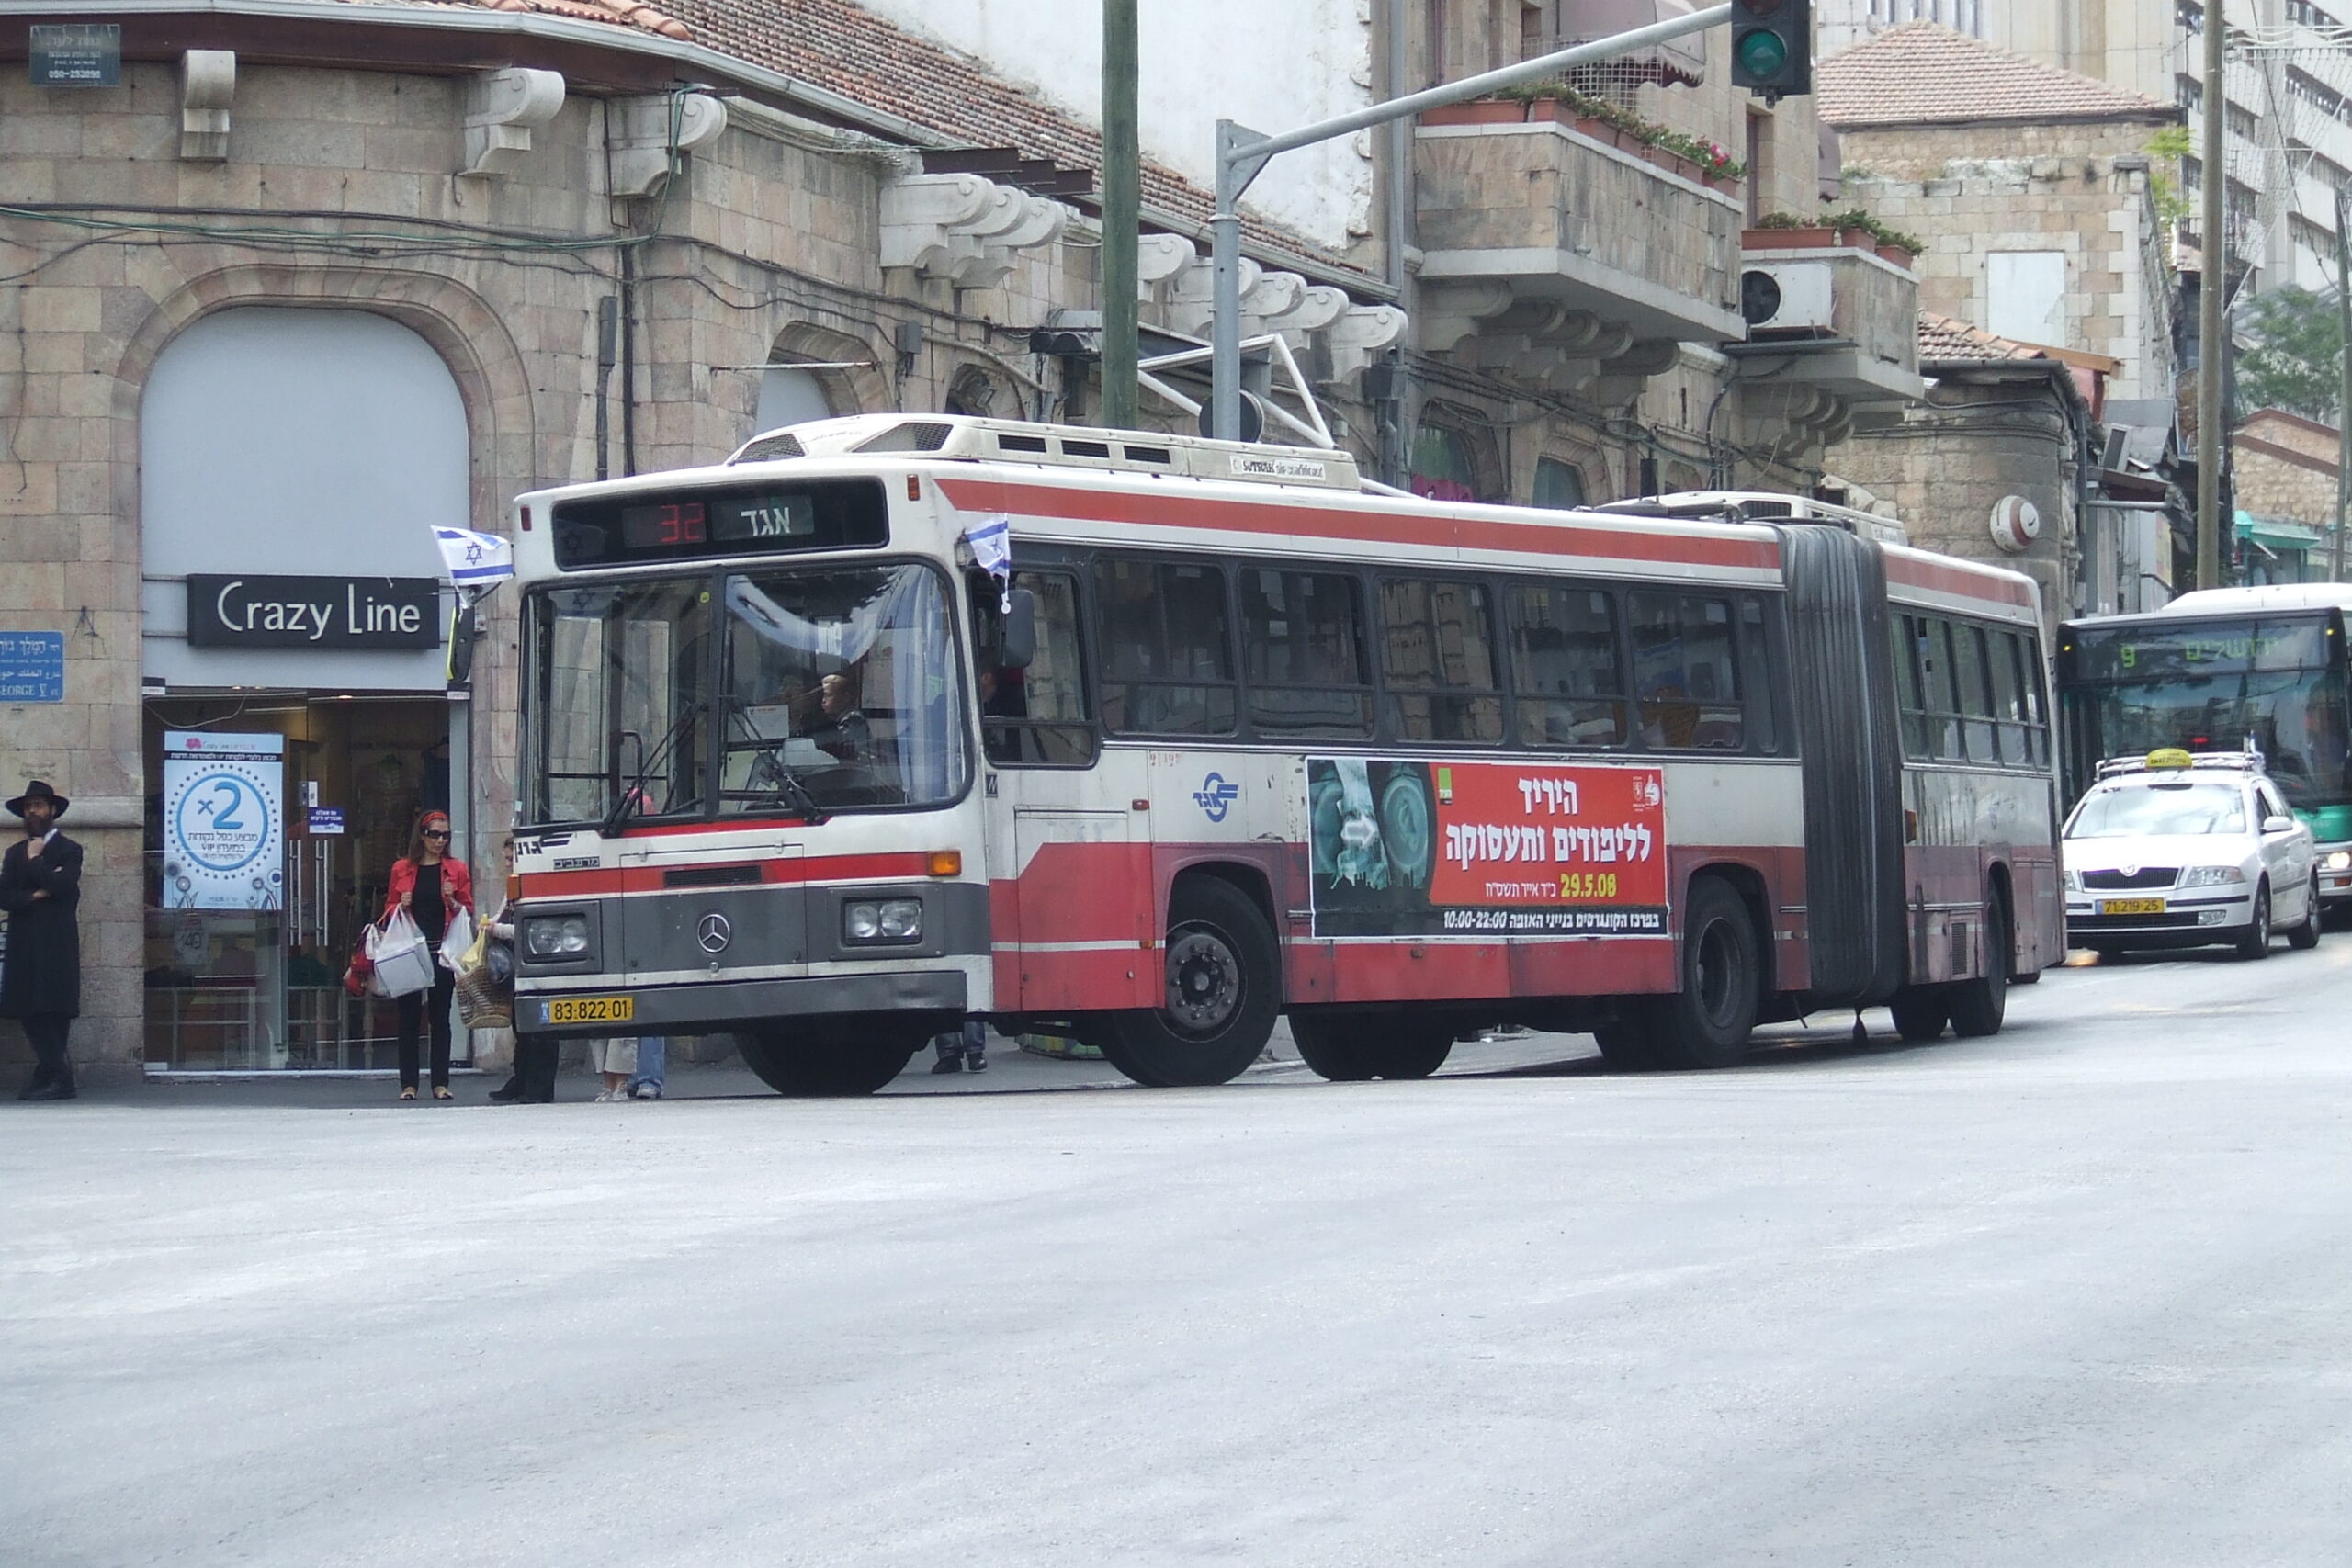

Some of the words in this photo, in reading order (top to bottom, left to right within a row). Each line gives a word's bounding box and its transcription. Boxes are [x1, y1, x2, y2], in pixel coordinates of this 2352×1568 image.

[662, 502, 706, 544] 32
[741, 506, 791, 536] אגד
[217, 581, 334, 640] Crazy
[347, 583, 421, 634] Line
[2120, 645, 2136, 668] 9
[0, 684, 35, 696] EORGE
[1518, 777, 1578, 814] היריד
[216, 830, 232, 842] כפל
[1445, 823, 1545, 871] ותעסוקה
[1552, 822, 1651, 863] ללימודים
[1521, 881, 1540, 897] אייר
[1560, 873, 1617, 897] 29.5.08
[1443, 910, 1507, 929] 10:00-22:00
[1510, 912, 1544, 929] האומה
[1576, 912, 1628, 931] הקונגרסים
[1630, 913, 1660, 928] במרכז
